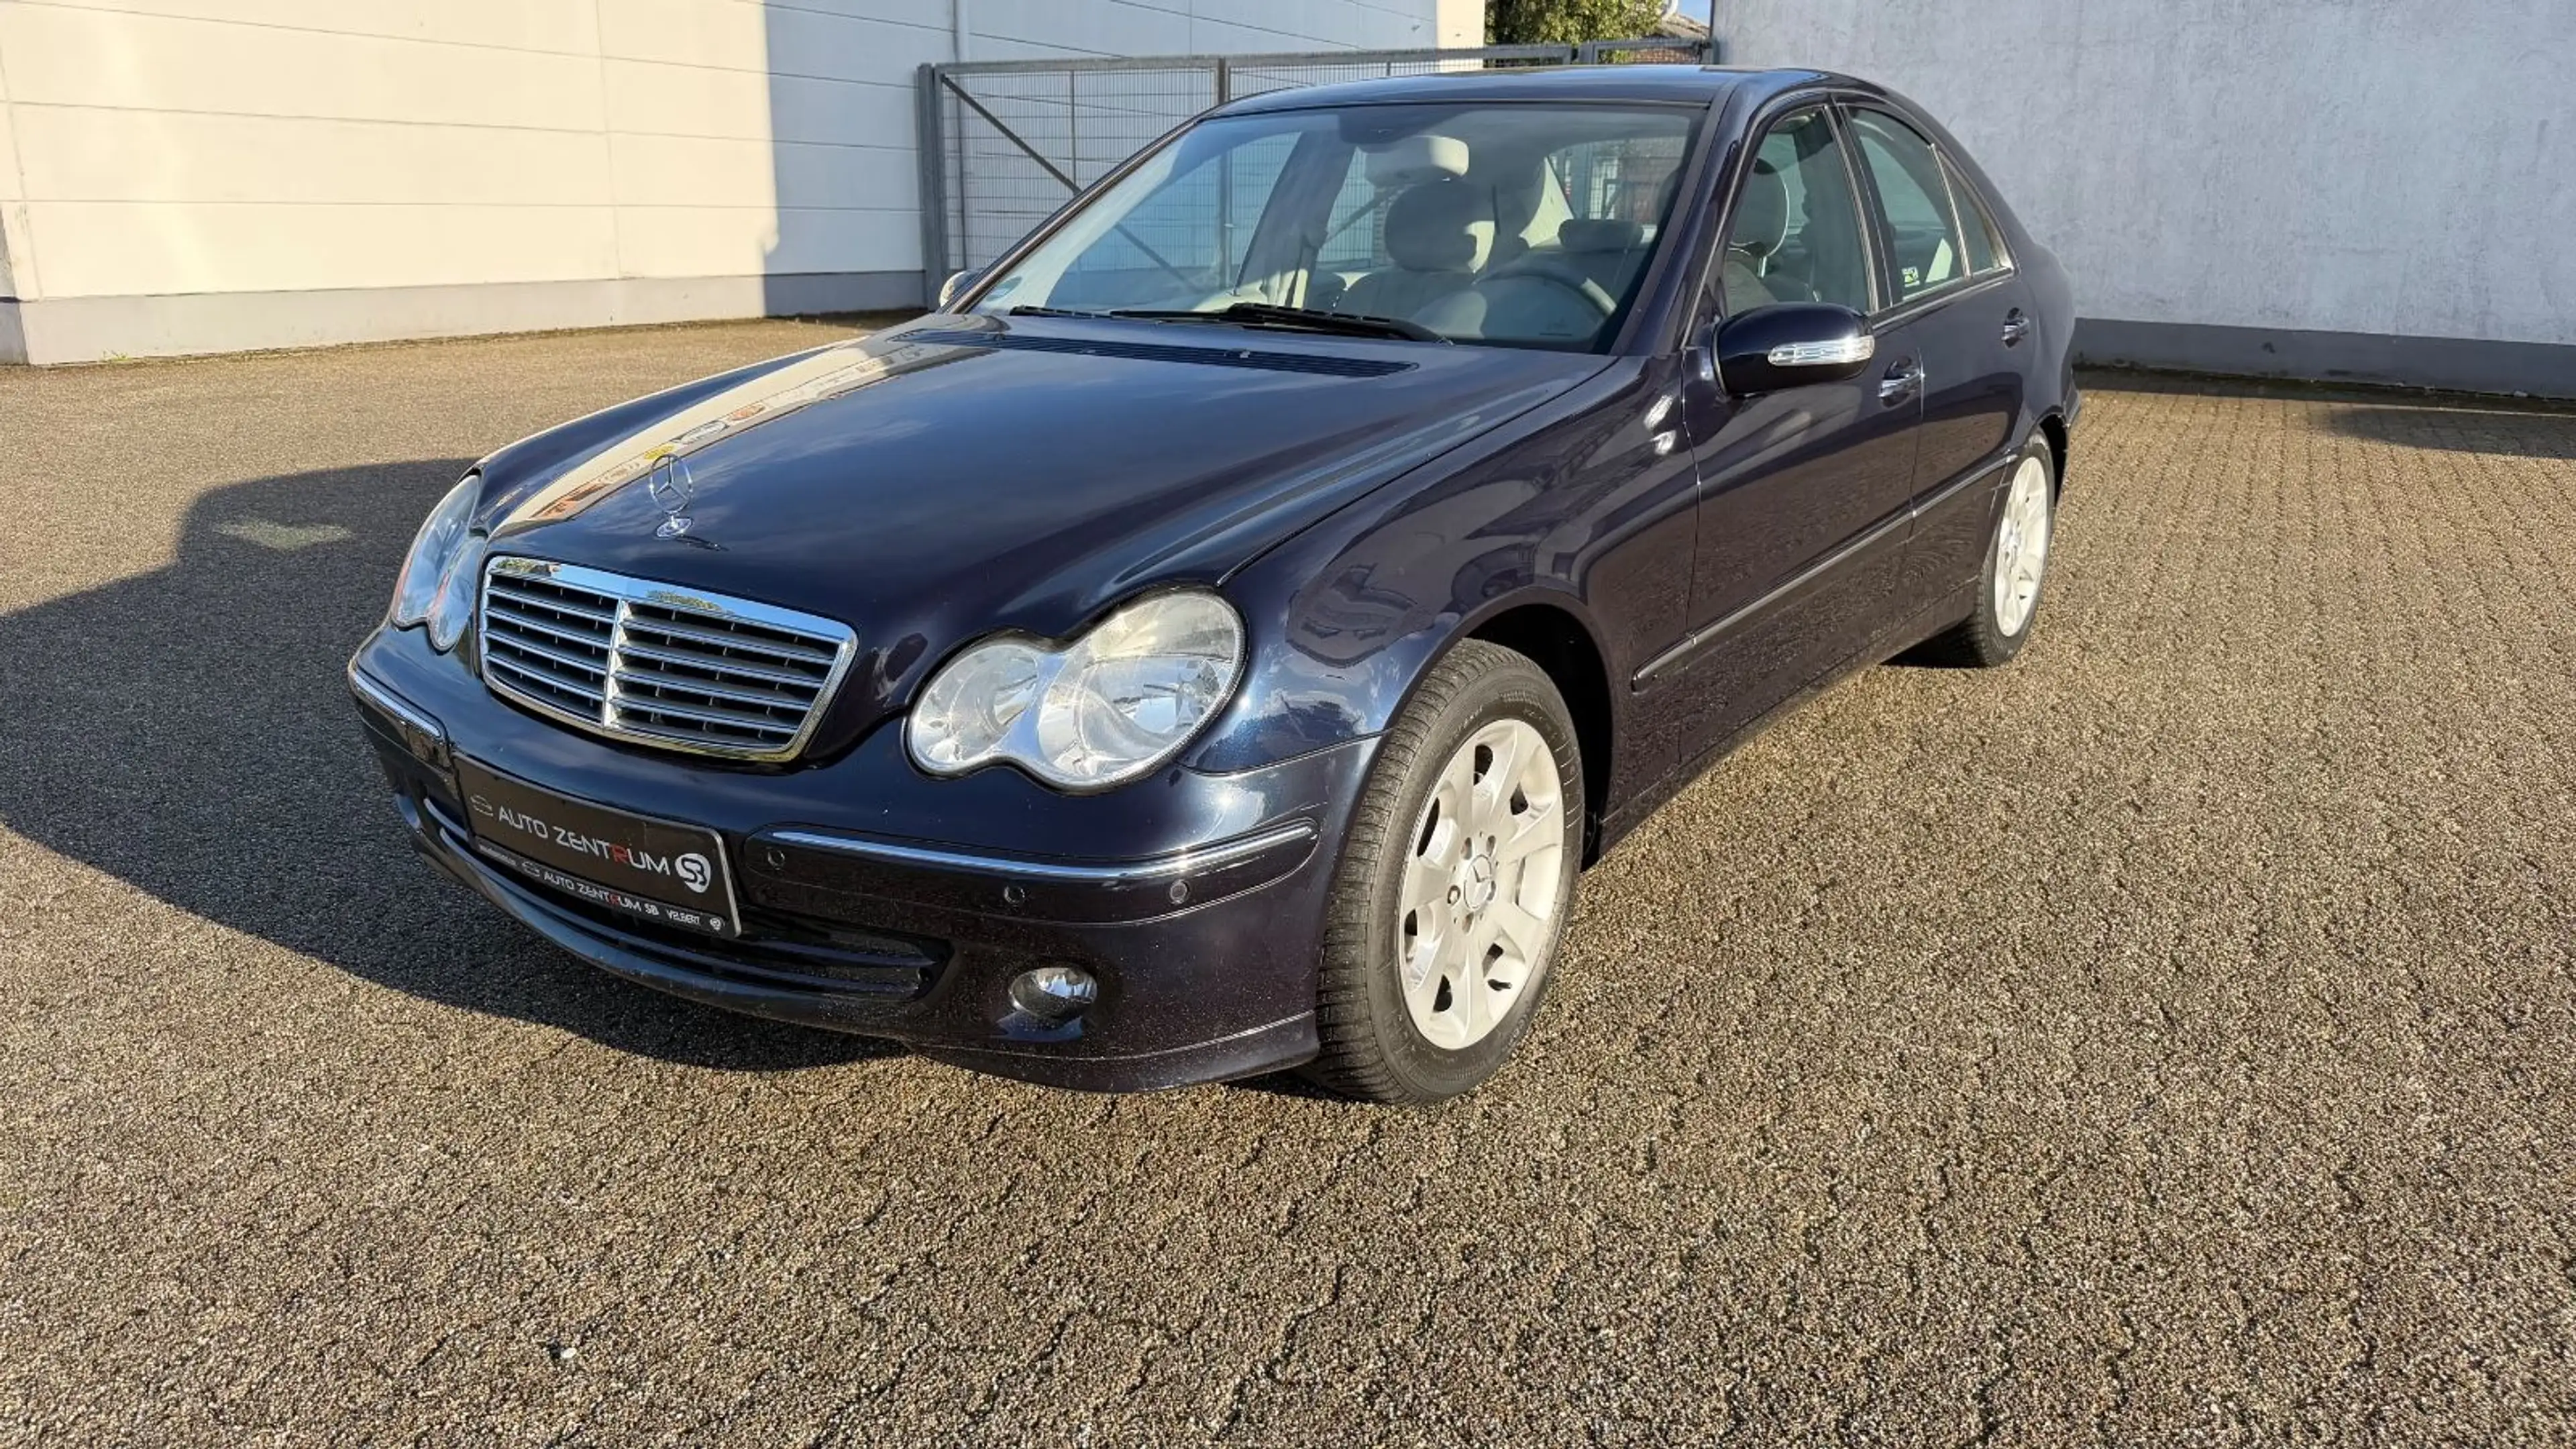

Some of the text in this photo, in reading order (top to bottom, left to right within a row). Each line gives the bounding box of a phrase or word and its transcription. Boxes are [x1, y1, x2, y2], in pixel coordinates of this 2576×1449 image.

[498, 806, 549, 839] AUTO
[553, 826, 671, 876] ZENTRUM
[544, 872, 575, 891] AUTO
[576, 882, 642, 912] ZENTRUM
